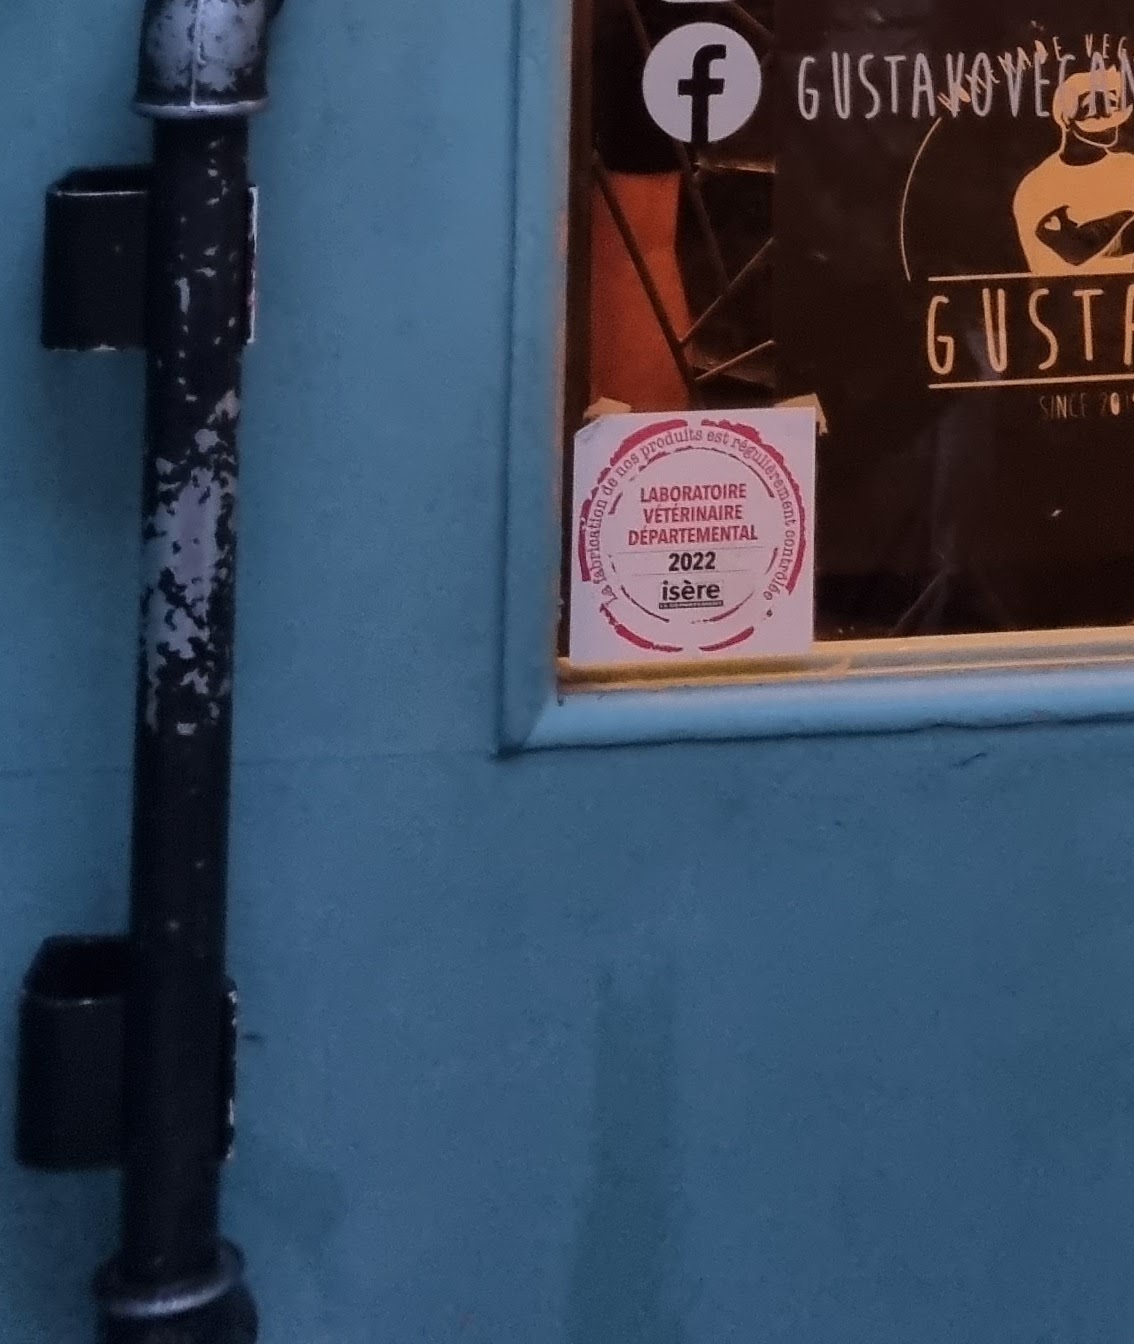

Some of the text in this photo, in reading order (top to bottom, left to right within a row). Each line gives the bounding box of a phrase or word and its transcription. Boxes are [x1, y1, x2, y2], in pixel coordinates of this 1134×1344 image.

[602, 477, 619, 496] de
[616, 453, 640, 477] nos
[640, 429, 703, 460] produits
[707, 430, 729, 444] est
[640, 484, 747, 502] LABORATOIRE
[643, 504, 743, 523] VÉTÉRINAIRE
[628, 524, 758, 546] DÉPARTEMENTAL
[668, 552, 716, 571] 2022
[661, 580, 720, 601] isère
